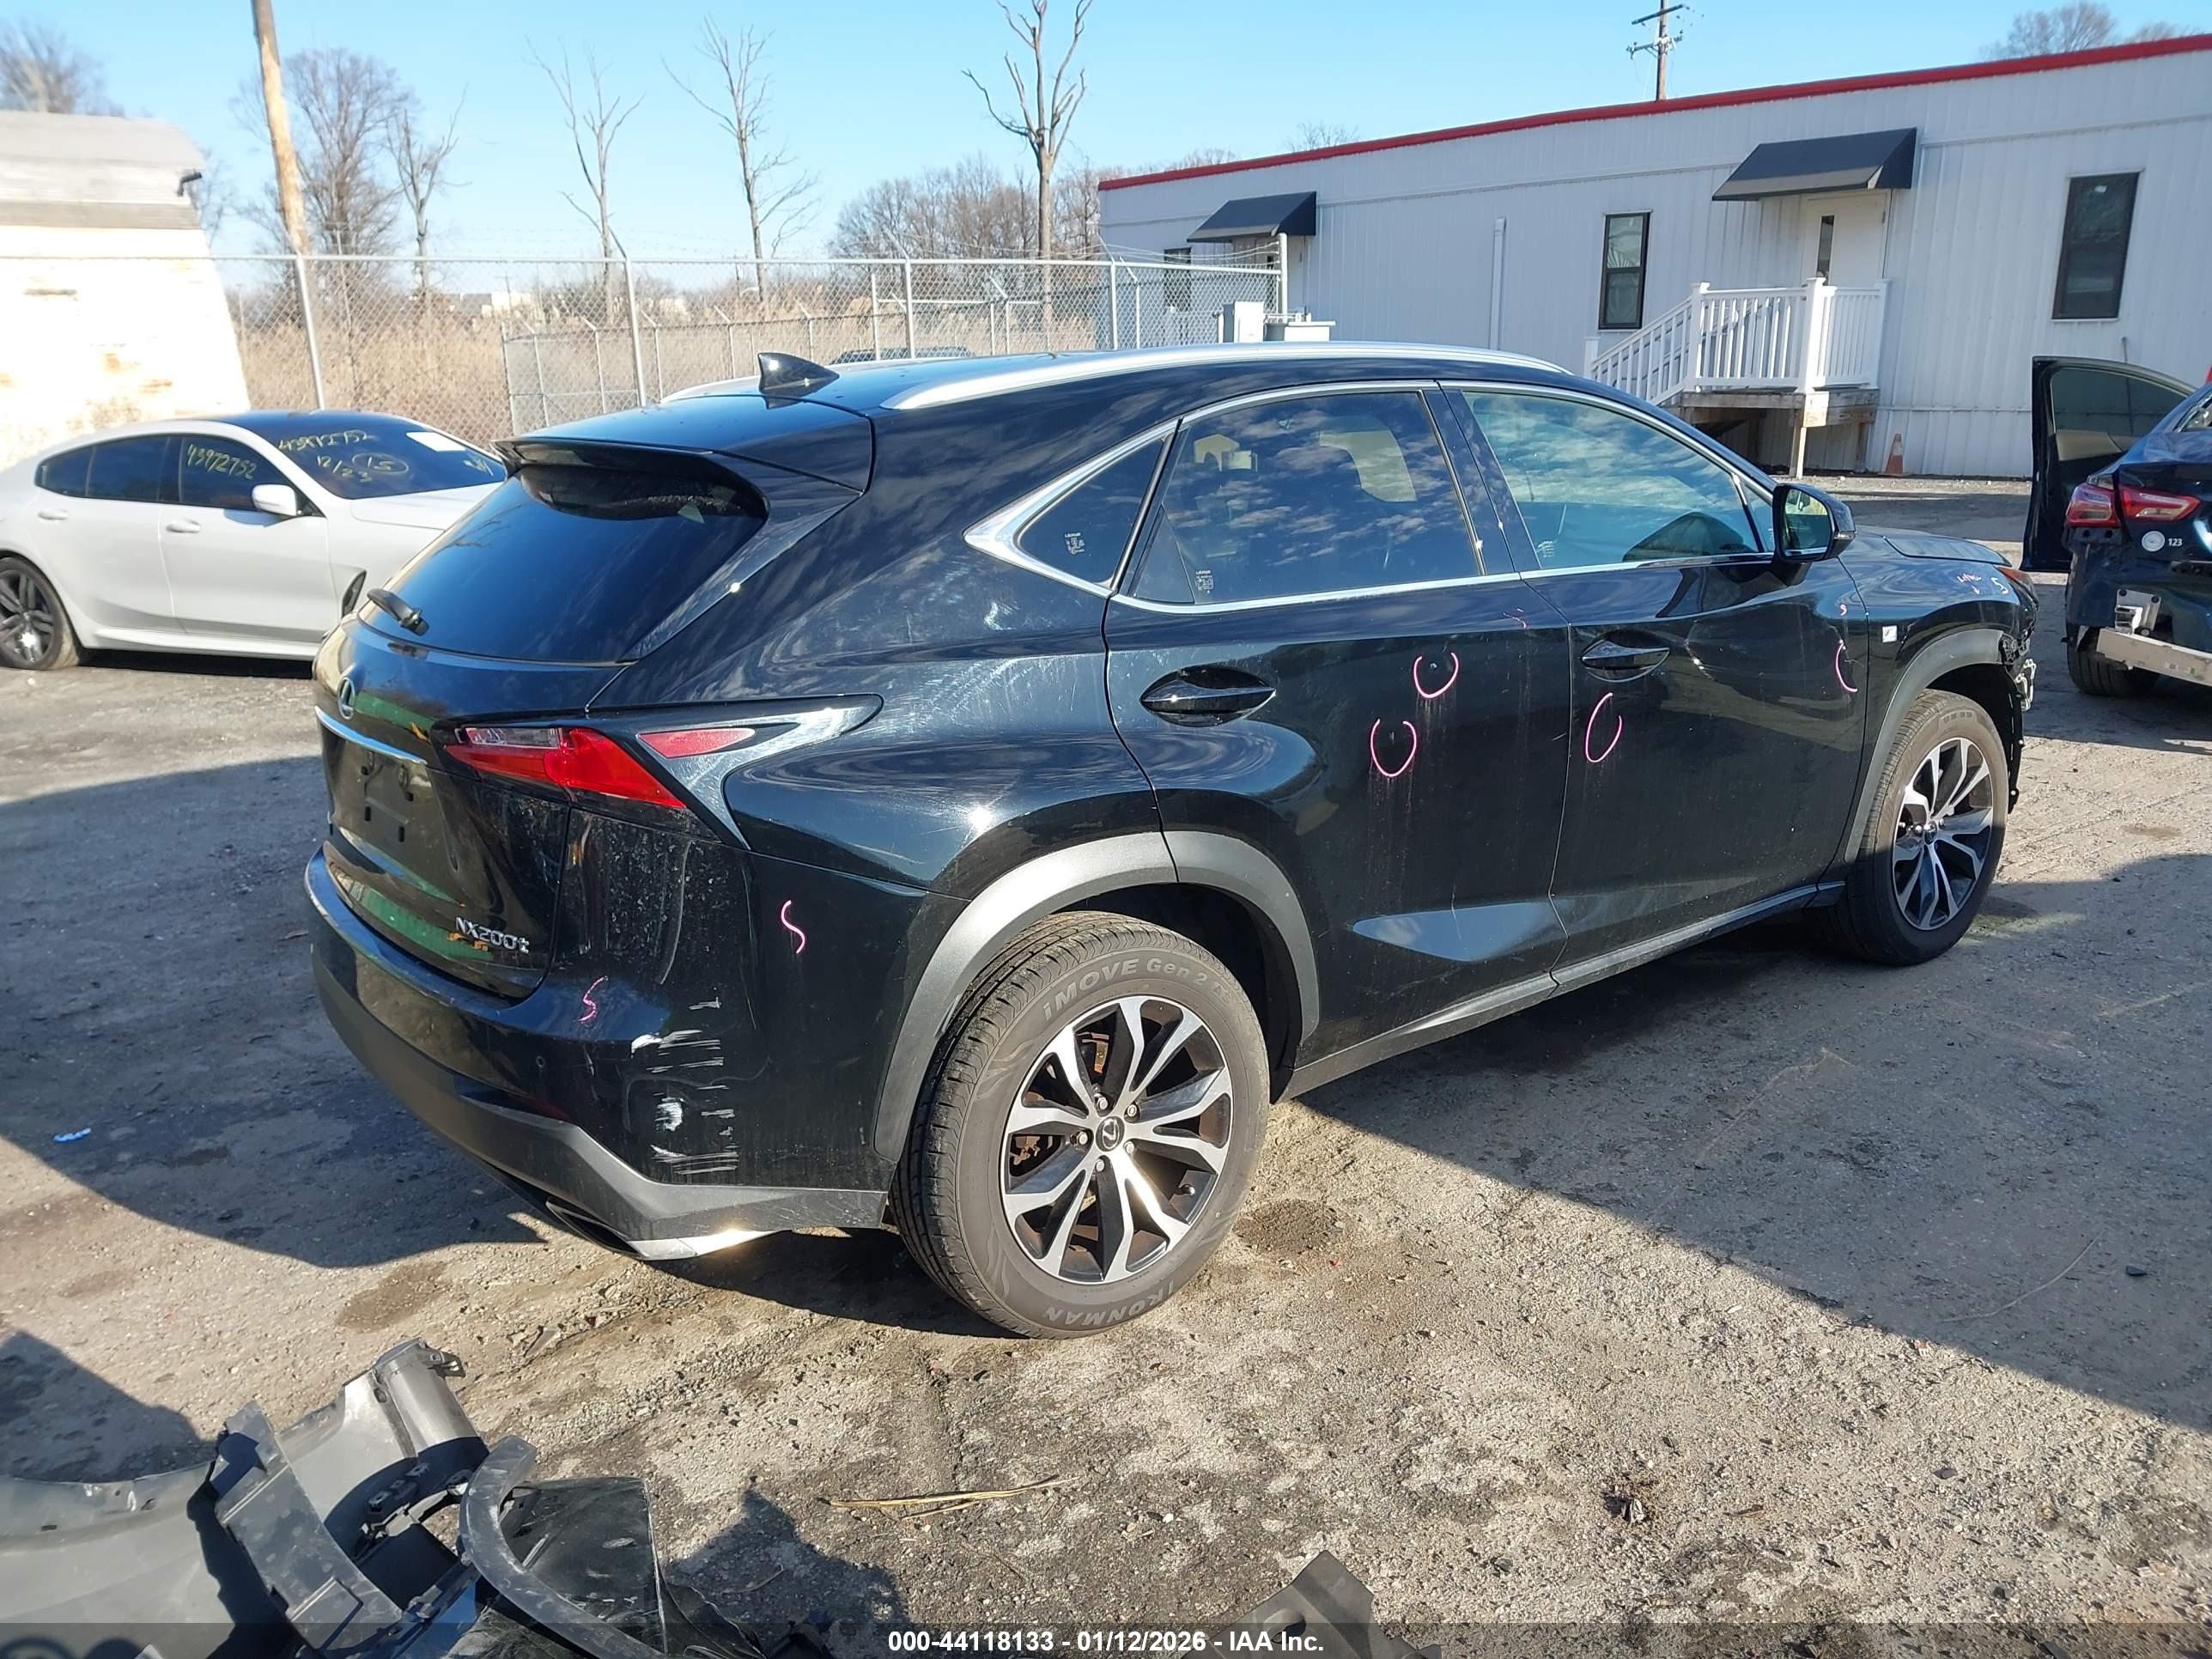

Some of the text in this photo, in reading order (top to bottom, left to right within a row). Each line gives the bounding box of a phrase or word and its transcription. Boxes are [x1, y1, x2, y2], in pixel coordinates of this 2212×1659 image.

[186, 443, 257, 481] 43972752
[455, 916, 530, 954] NX200t
[1146, 957, 1191, 979] Gen
[1194, 972, 1208, 986] 2
[1042, 1280, 1175, 1327] IRONMAN
